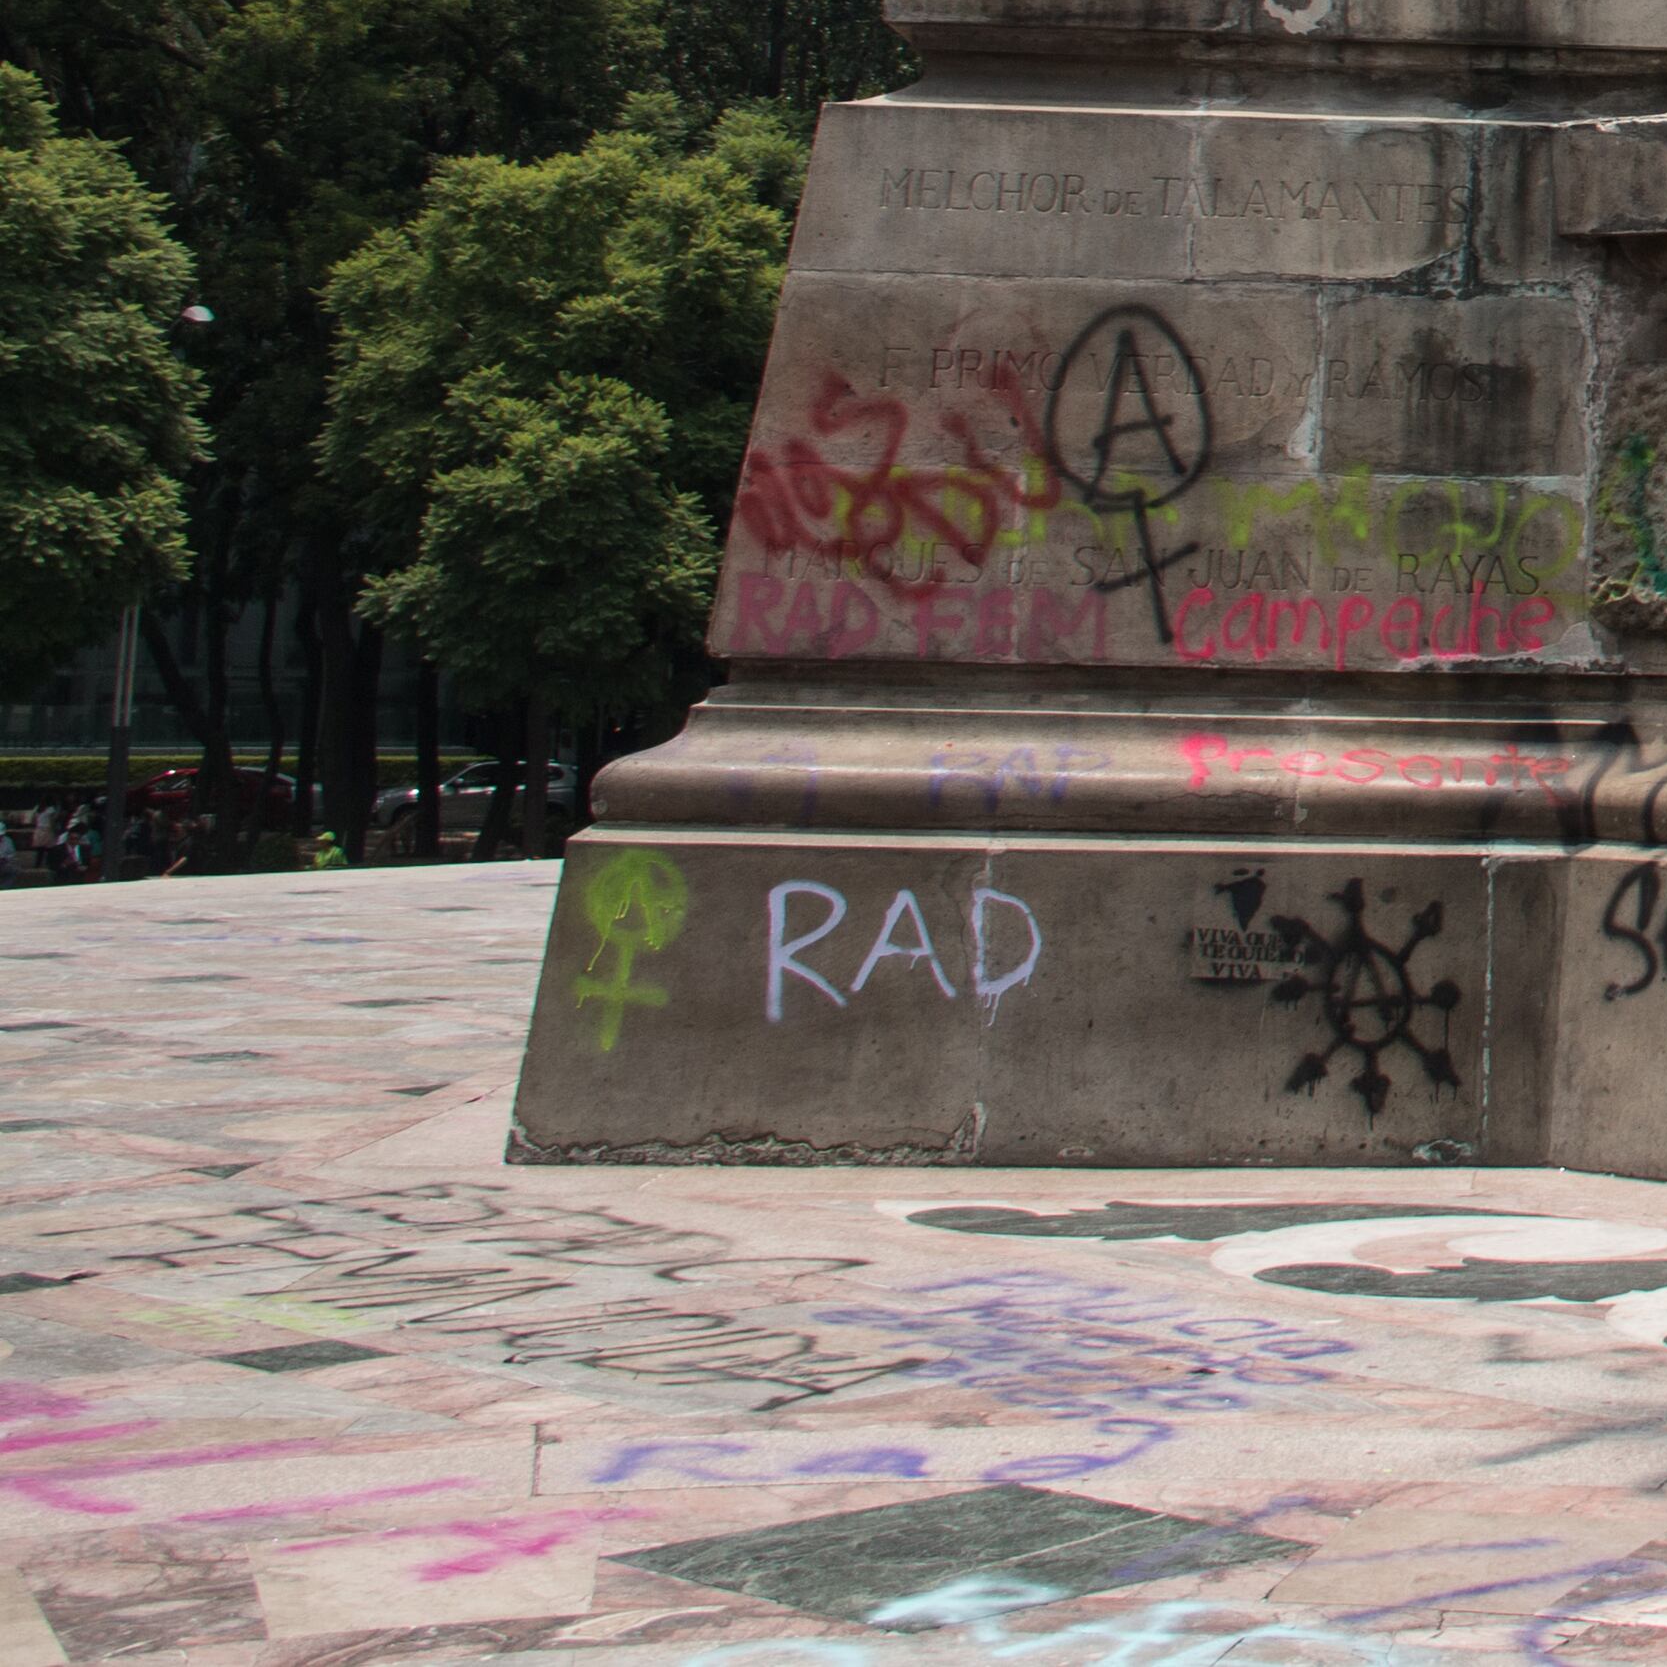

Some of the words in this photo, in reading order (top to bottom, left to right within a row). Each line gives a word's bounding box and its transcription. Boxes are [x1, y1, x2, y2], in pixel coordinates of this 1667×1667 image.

[880, 167, 1086, 215] MELCHOR
[1152, 175, 1474, 225] TALAMANTES
[928, 347, 1066, 393] PRIMO
[1068, 545, 1168, 588] SAN
[1190, 547, 1312, 591] JUAN
[1330, 565, 1375, 593] DE
[728, 569, 880, 661] RAD
[765, 879, 1046, 1025] RAD
[1211, 963, 1262, 979] VIVA
